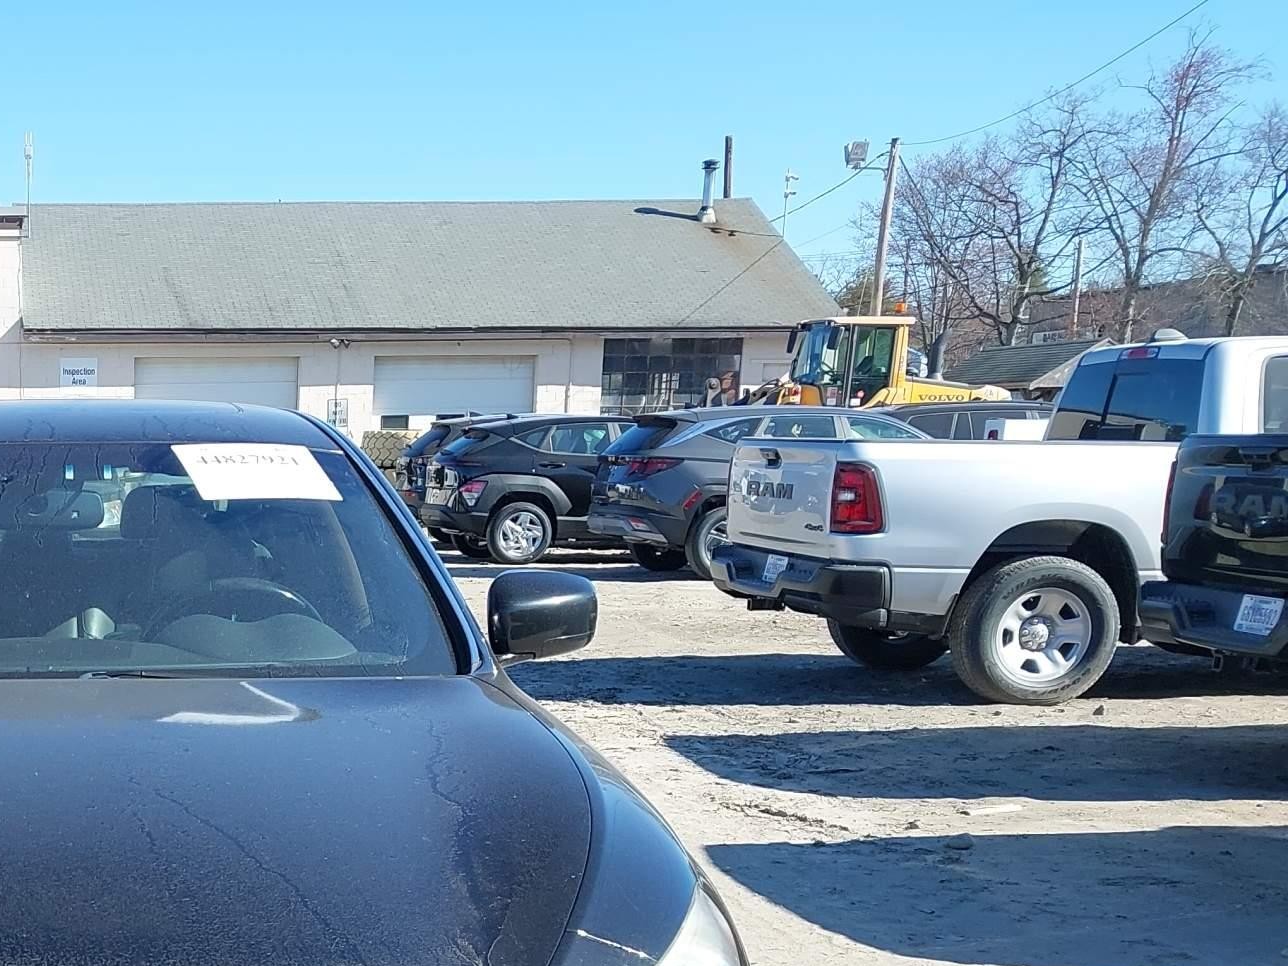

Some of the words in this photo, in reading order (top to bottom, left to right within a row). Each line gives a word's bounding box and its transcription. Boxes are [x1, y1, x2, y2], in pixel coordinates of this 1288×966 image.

[62, 367, 96, 377] Inspection
[71, 377, 87, 385] Area
[196, 455, 300, 466] 44827921
[746, 480, 794, 500] RAM
